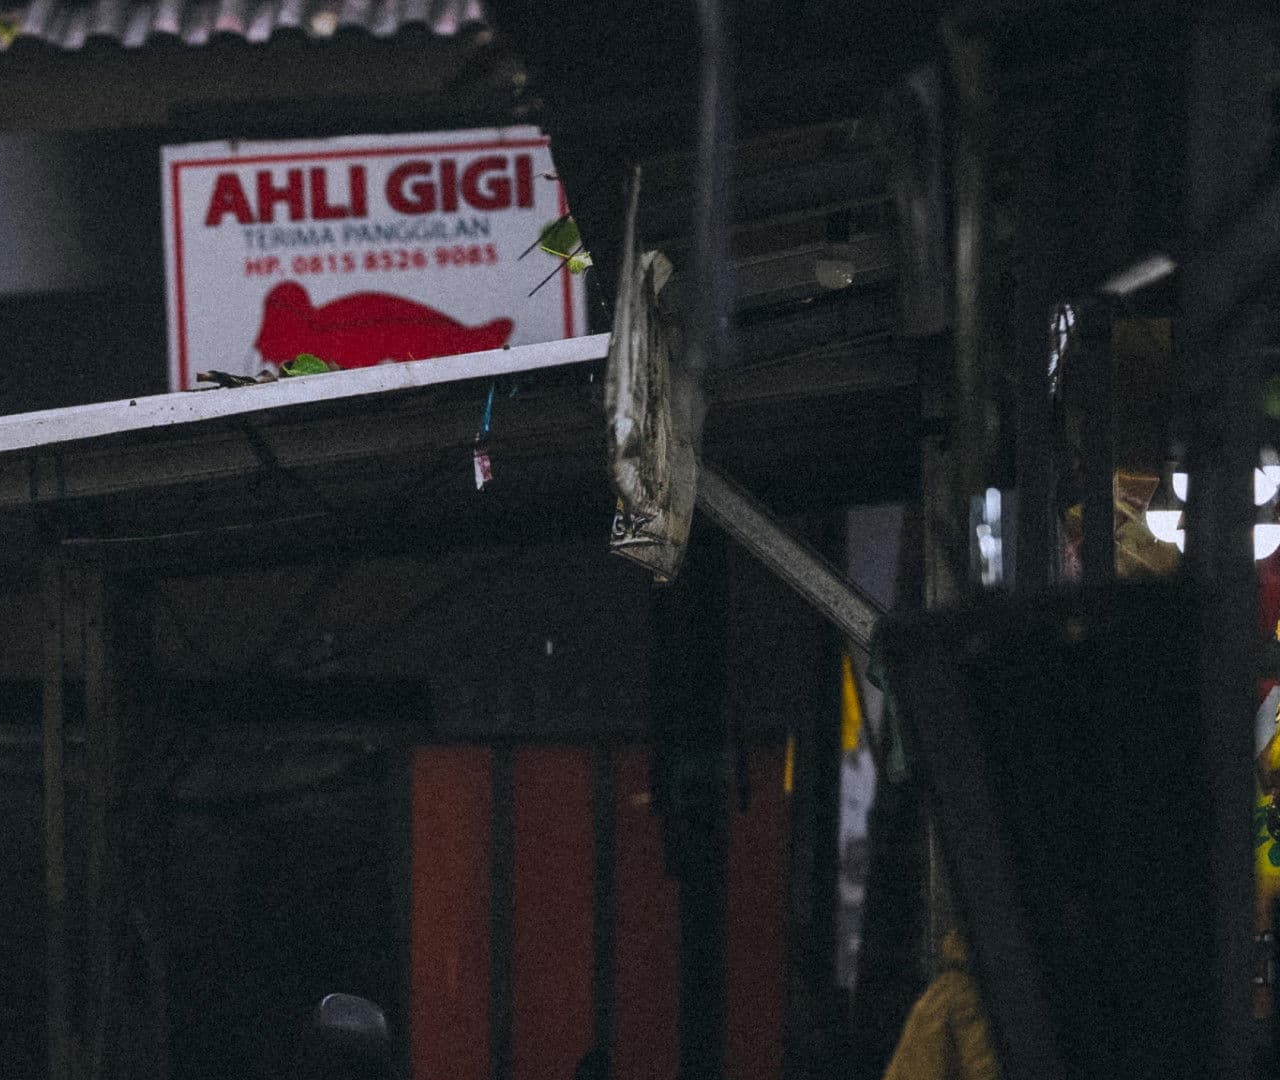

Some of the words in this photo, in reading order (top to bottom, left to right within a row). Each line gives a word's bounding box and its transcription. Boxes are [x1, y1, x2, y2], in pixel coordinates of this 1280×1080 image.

[205, 164, 369, 227] AHLI
[385, 154, 535, 216] GIGI
[243, 226, 336, 250] TERIMA
[342, 217, 490, 245] PANGGILAN
[291, 252, 356, 276] 0815
[362, 249, 429, 272] 8526
